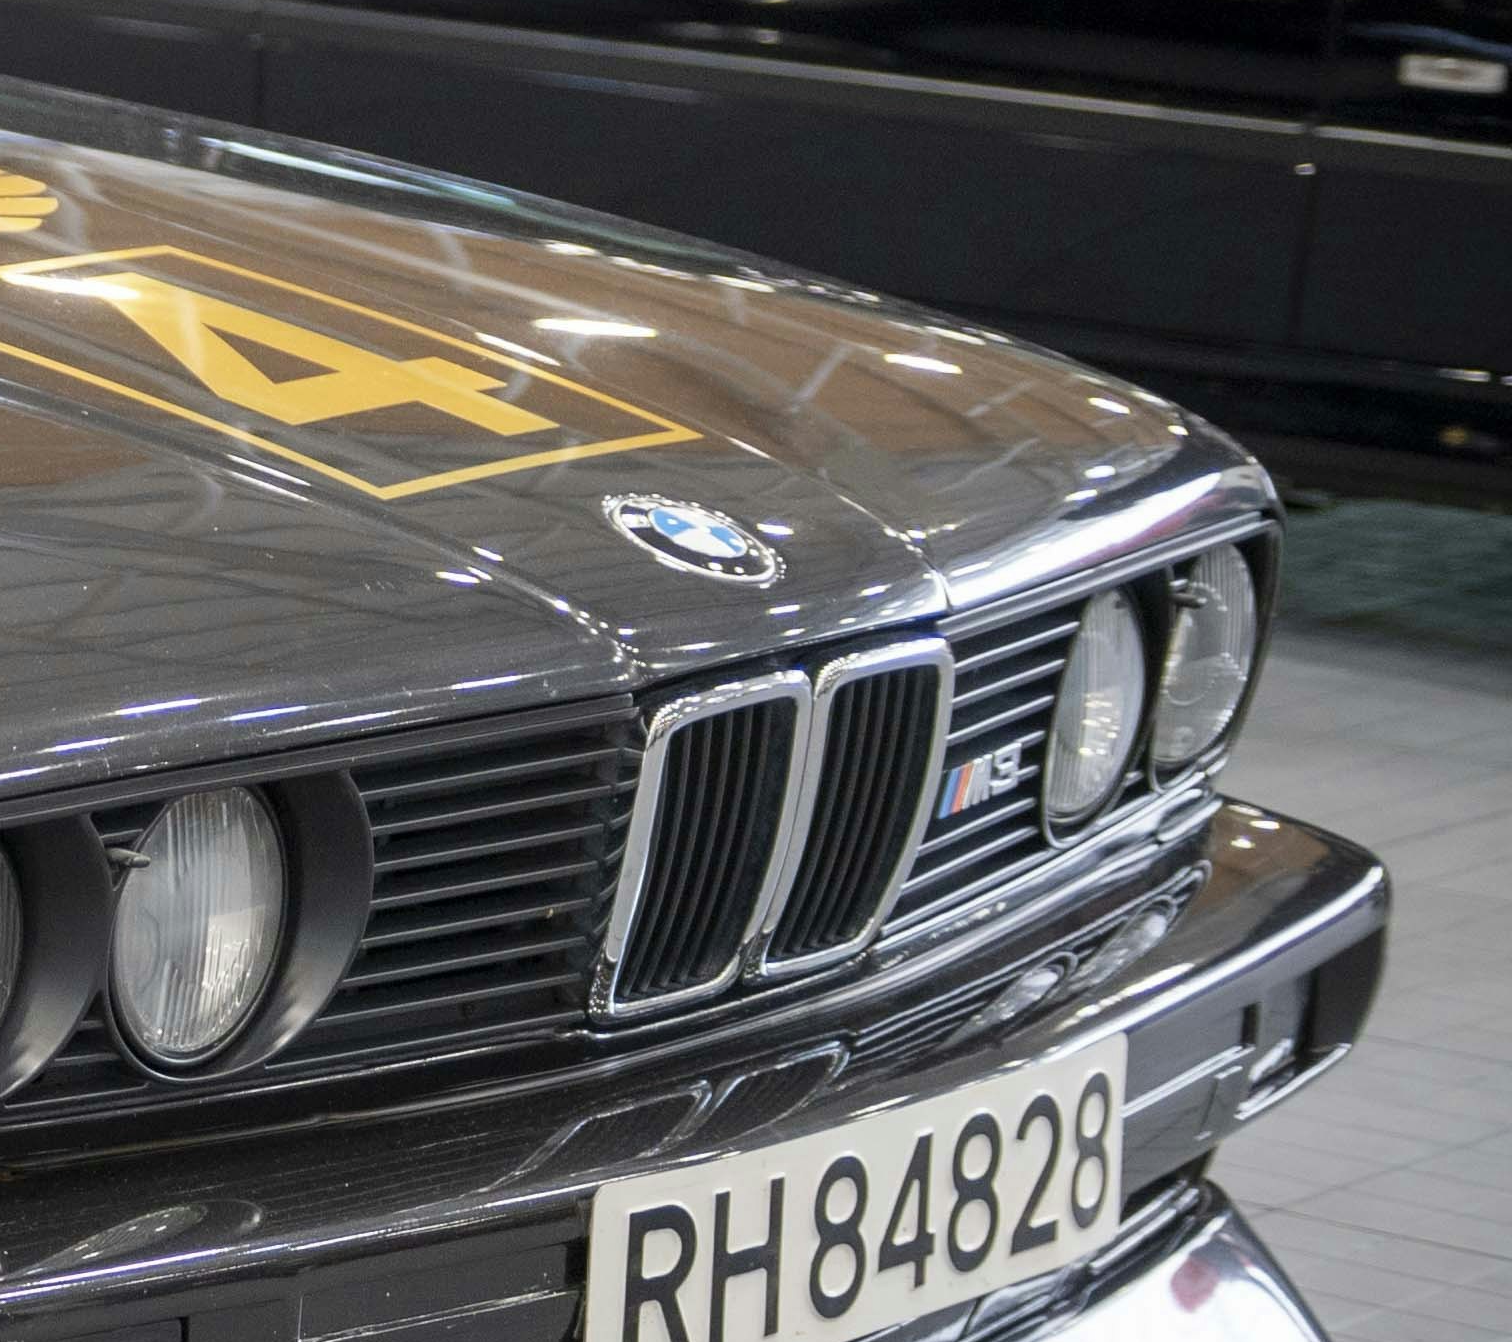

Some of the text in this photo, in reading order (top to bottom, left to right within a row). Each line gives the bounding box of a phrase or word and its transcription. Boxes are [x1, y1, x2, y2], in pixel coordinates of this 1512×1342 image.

[80, 271, 561, 438] 4
[954, 742, 1023, 813] M3
[808, 1071, 1112, 1321] 84828
